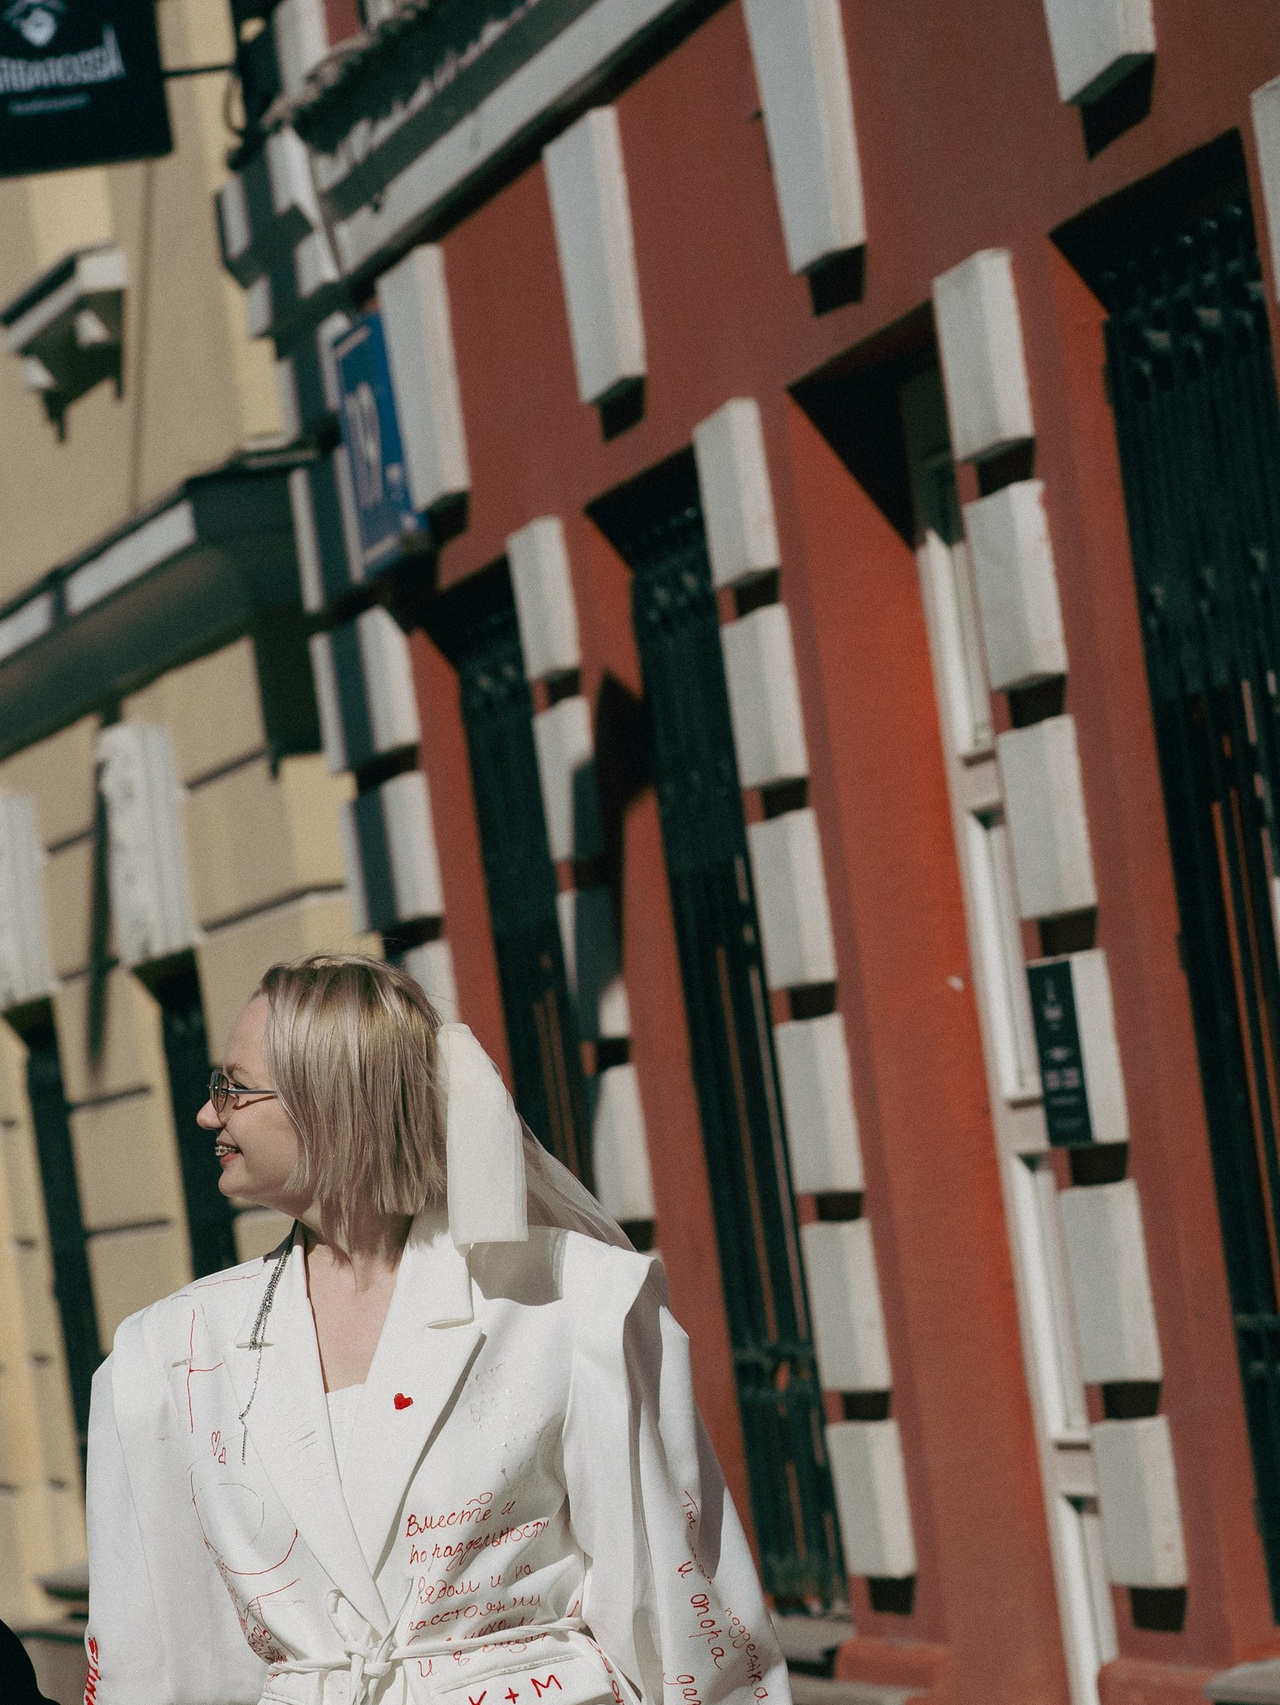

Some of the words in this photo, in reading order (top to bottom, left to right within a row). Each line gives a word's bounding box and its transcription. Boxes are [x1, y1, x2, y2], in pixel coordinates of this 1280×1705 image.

[405, 1505, 492, 1538] Вместе
[677, 1560, 694, 1579] и
[688, 1593, 725, 1671] опора
[530, 1674, 563, 1698] M
